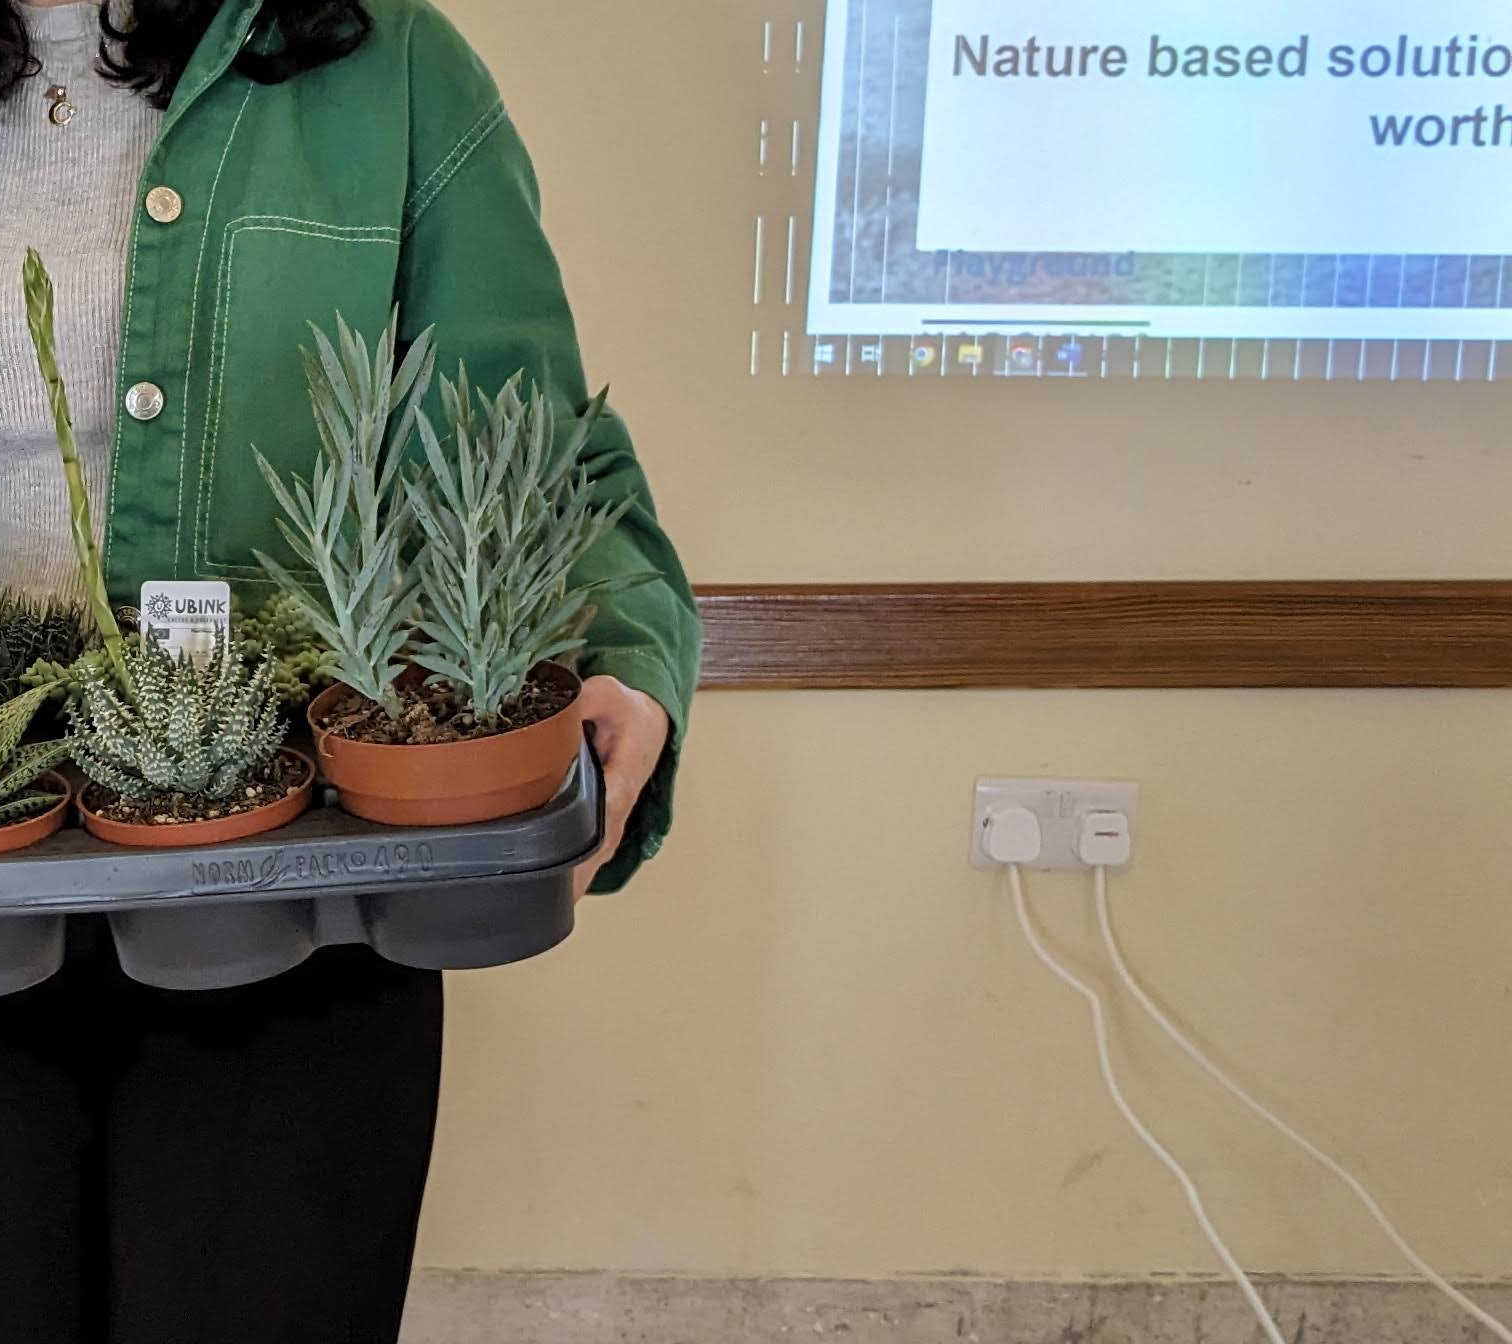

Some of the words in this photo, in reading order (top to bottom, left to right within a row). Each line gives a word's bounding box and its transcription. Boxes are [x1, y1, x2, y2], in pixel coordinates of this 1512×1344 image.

[952, 34, 1128, 79] Nature
[1147, 34, 1309, 79] based
[1327, 34, 1512, 78] solutio
[1369, 104, 1512, 147] worth
[175, 598, 227, 614] UBINK
[192, 860, 255, 885] NORM
